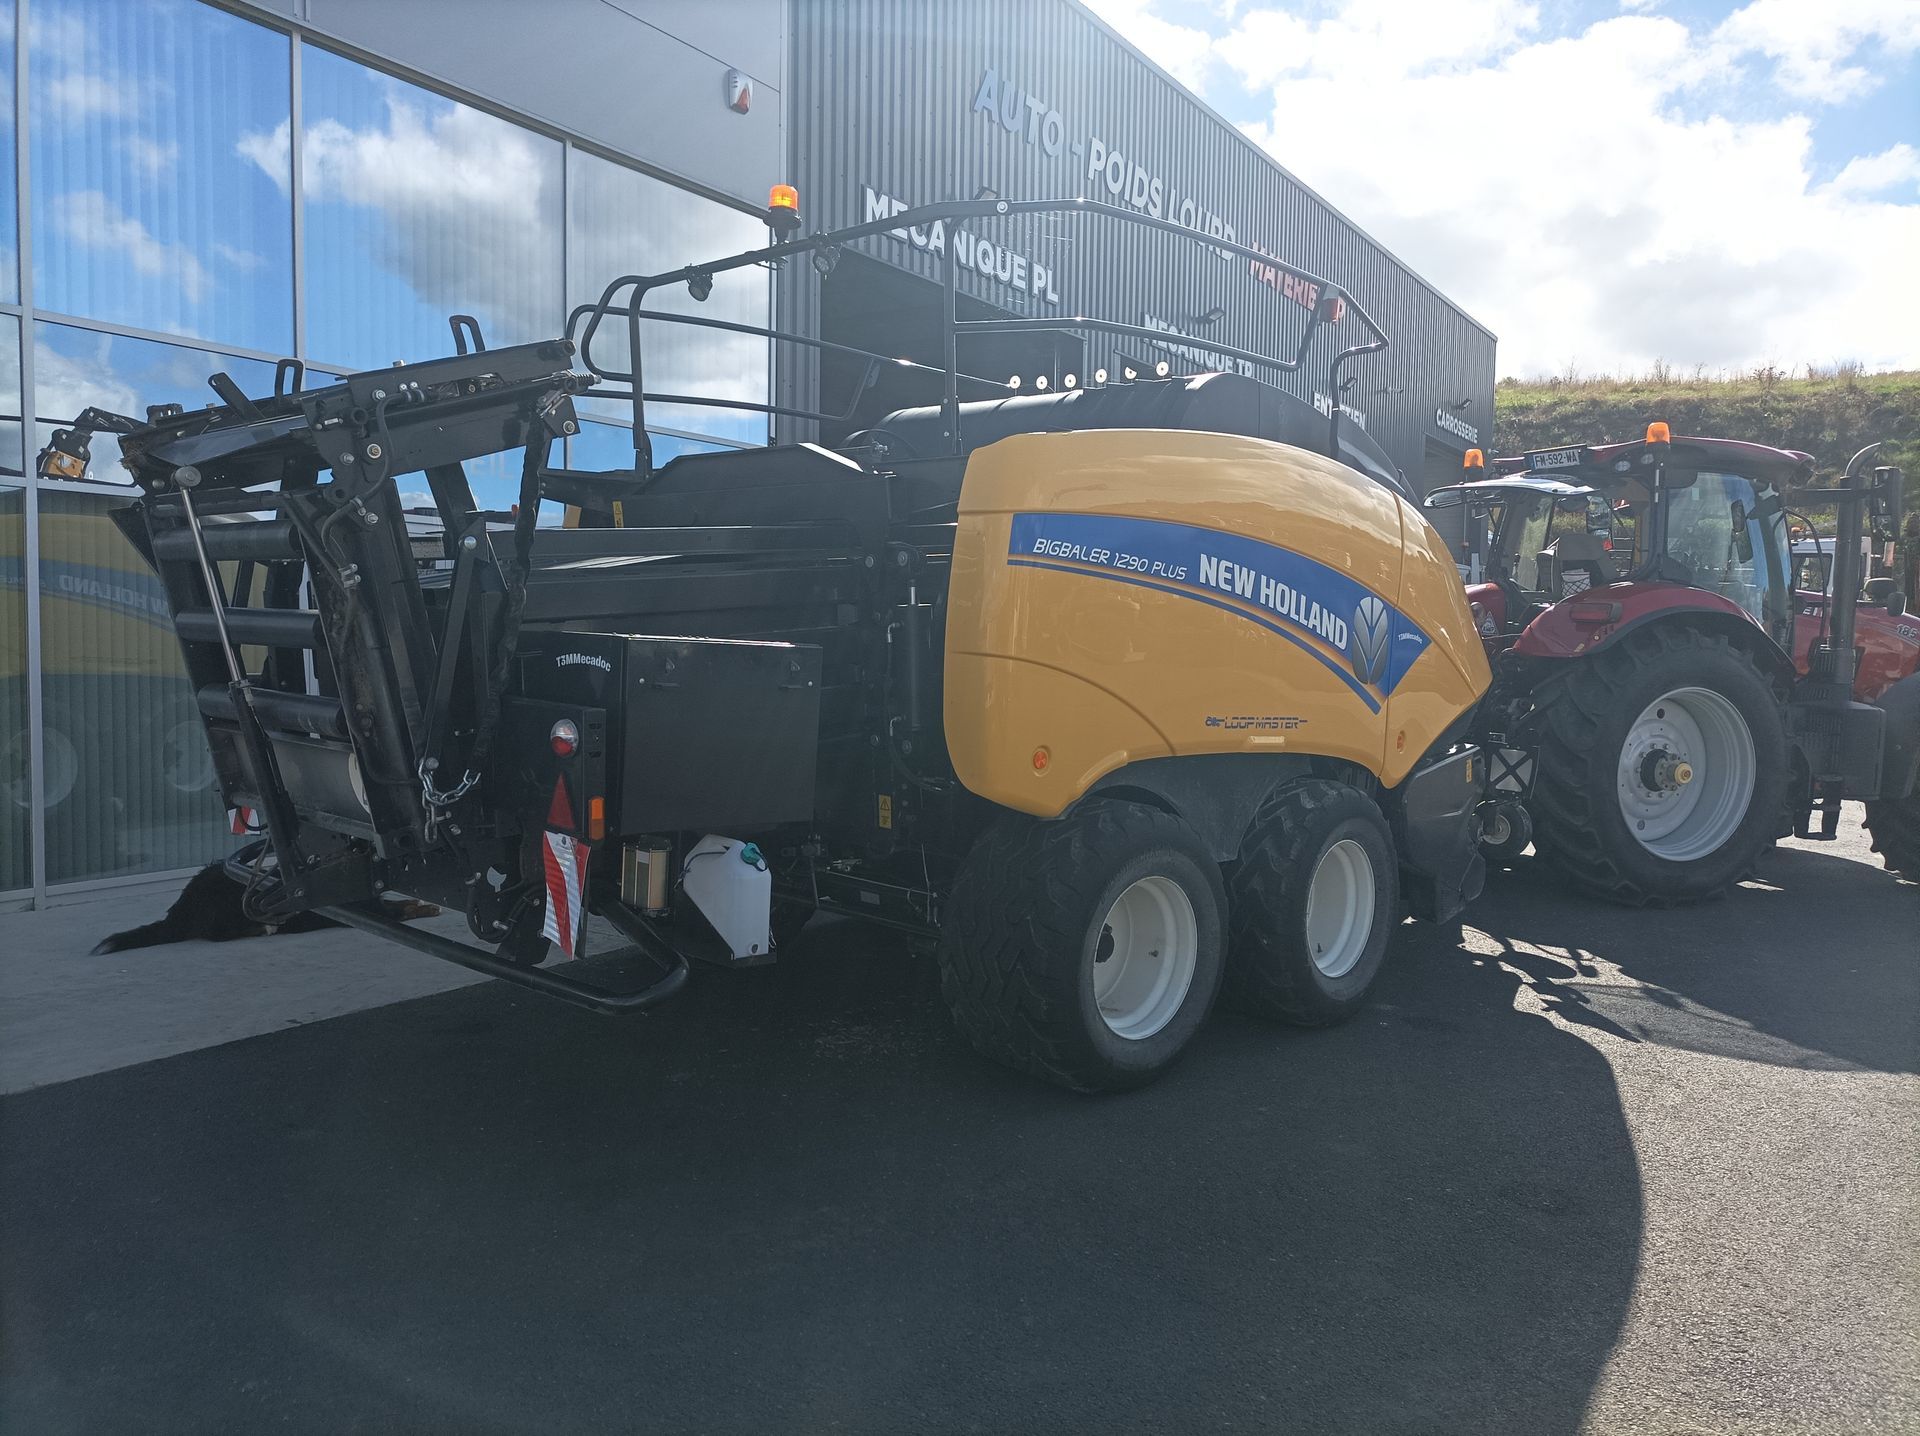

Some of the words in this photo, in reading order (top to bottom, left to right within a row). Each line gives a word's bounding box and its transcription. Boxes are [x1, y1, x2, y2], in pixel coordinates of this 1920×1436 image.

[973, 67, 1065, 157] AUTO
[1088, 136, 1163, 217] POIDS
[1168, 188, 1236, 260] LOURD
[865, 187, 1027, 290] MECANIQUE
[1032, 263, 1059, 303] PL
[1436, 408, 1478, 445] CARROSSERIE
[1534, 451, 1578, 468] FM-592-WA
[1032, 538, 1111, 564] BIGBALER
[1113, 552, 1148, 572] 1290
[1151, 561, 1188, 580] PLUS
[1199, 553, 1256, 599] NEW
[1259, 574, 1348, 650] HOLLAND
[555, 653, 612, 672] T3MMecadoc
